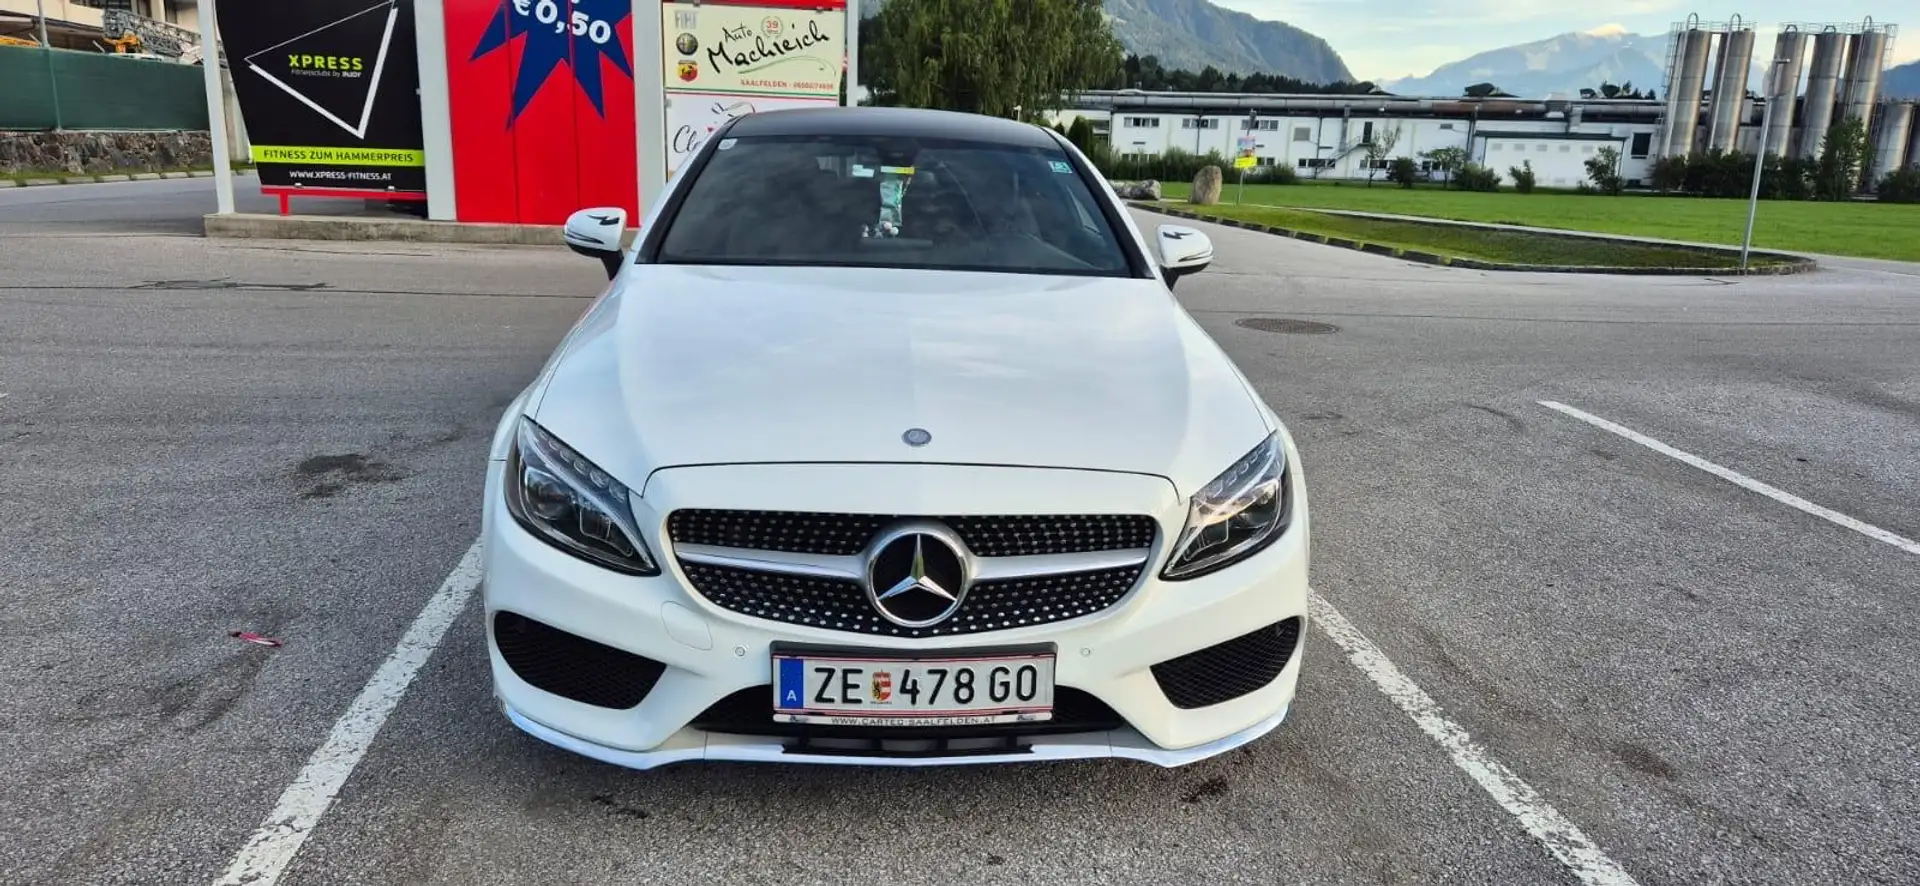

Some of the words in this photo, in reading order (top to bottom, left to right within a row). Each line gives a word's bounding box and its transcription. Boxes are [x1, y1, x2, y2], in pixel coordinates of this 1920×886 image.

[722, 22, 753, 43] Auto
[707, 20, 830, 74] Machreich
[288, 54, 363, 71] XPRESS
[263, 150, 307, 160] FITNESS
[309, 151, 333, 161] ZUM
[336, 152, 414, 163] HAMMERPREIS
[290, 170, 392, 181] WWW.XPRESS-FITNESS.AT
[814, 667, 864, 704] ZE
[899, 667, 976, 706] 478
[786, 690, 797, 702] A
